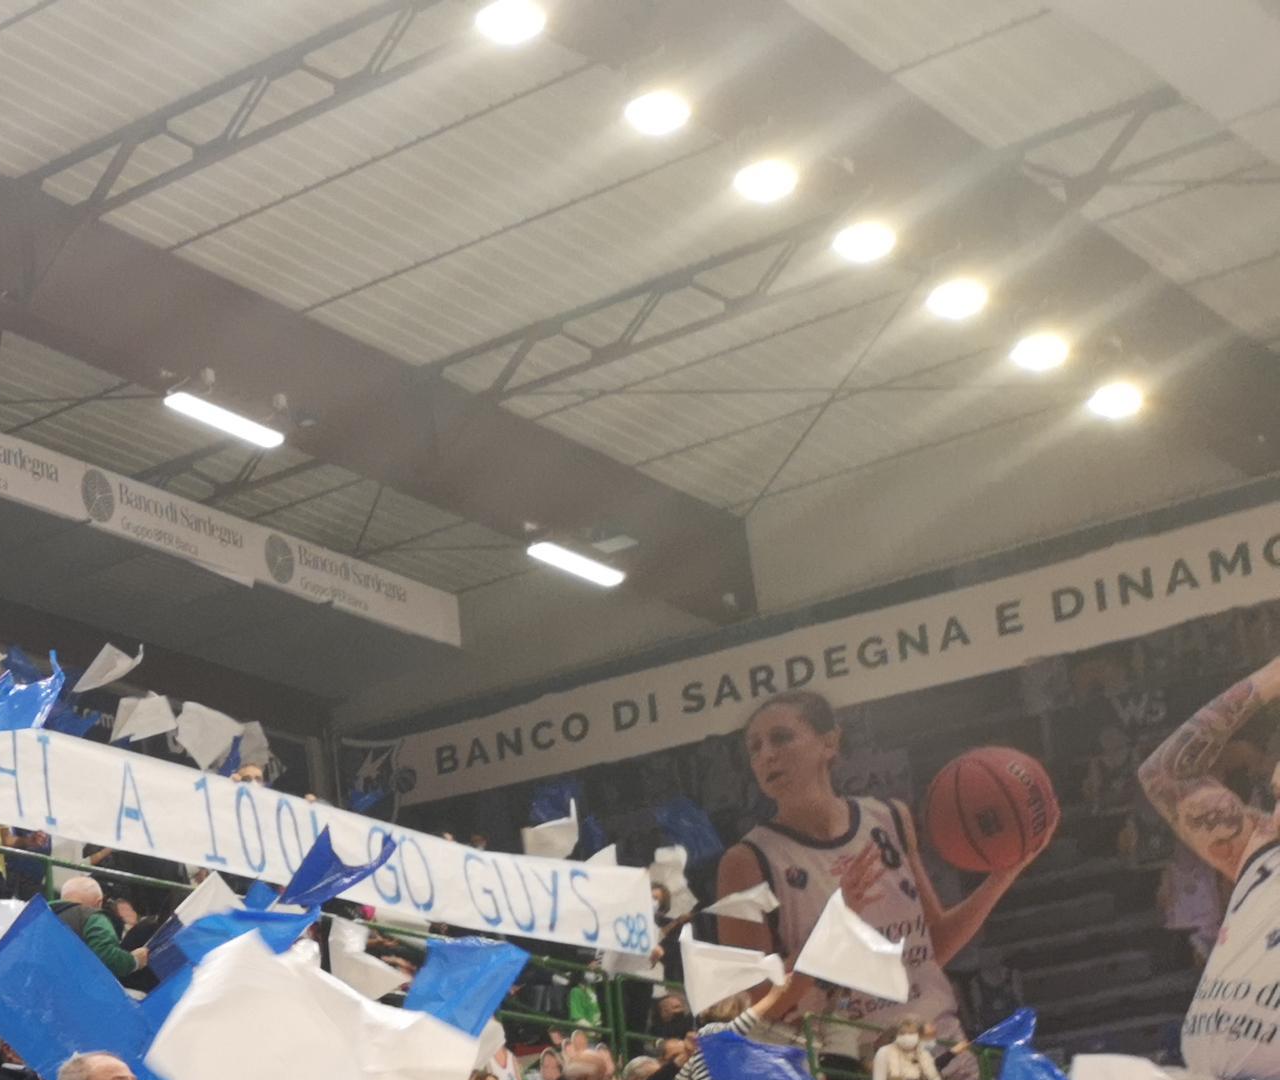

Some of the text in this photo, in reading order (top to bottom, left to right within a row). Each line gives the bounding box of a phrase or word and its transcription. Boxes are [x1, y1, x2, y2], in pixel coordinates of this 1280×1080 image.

[435, 711, 590, 777] BANCO
[612, 692, 659, 733] DI
[681, 615, 971, 715] SARDEGNA
[995, 599, 1024, 637] E
[115, 760, 155, 849] A
[463, 853, 600, 942] GUYS
[1184, 1006, 1279, 1045] ardegna
